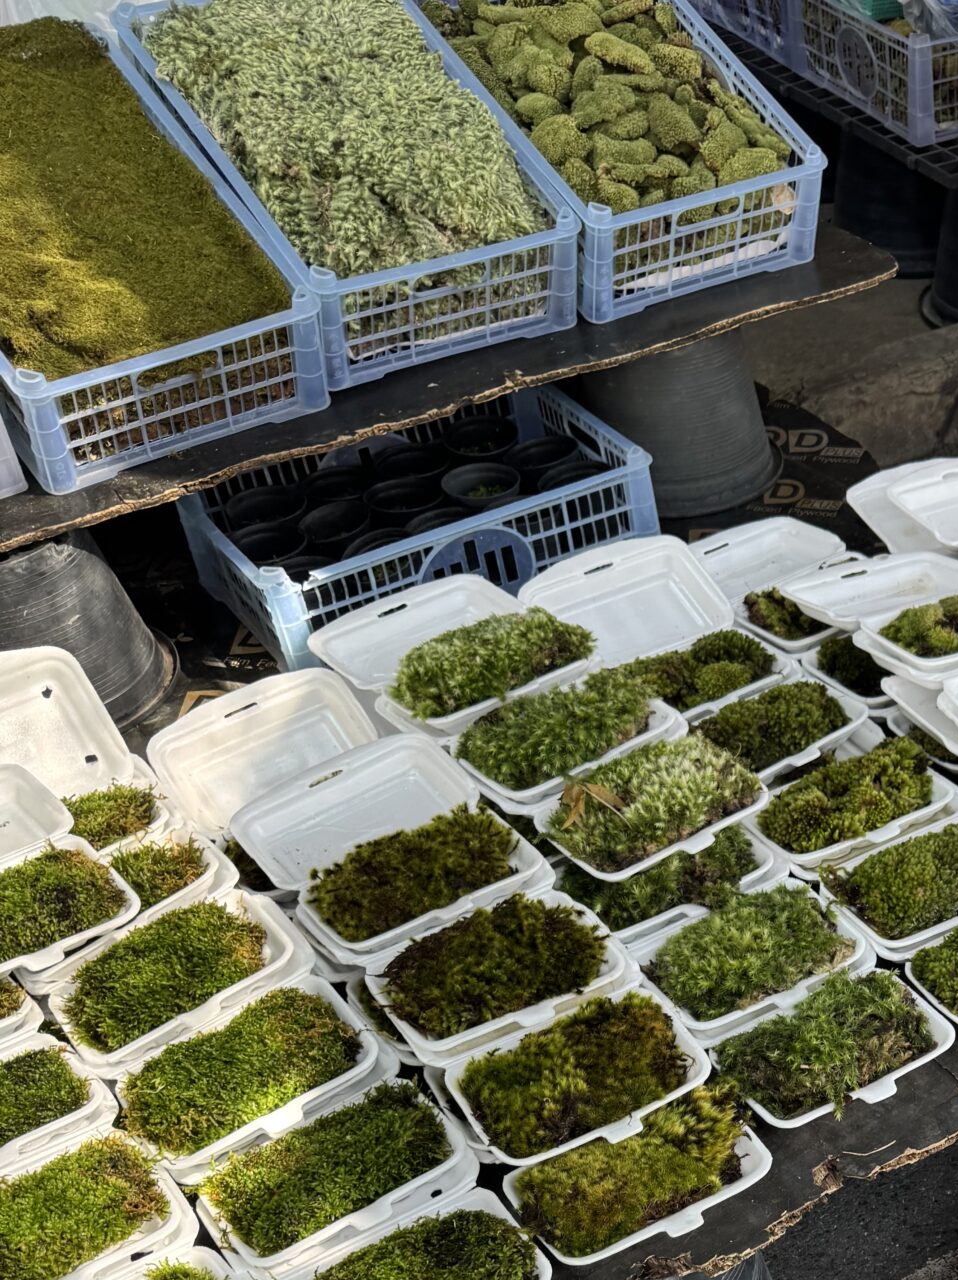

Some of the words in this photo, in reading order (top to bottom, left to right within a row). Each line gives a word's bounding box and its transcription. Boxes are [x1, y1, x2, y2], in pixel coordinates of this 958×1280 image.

[821, 447, 863, 458] PLUS
[812, 456, 861, 465] Plywood
[796, 500, 844, 511] PLUS
[787, 506, 839, 518] Plywood
